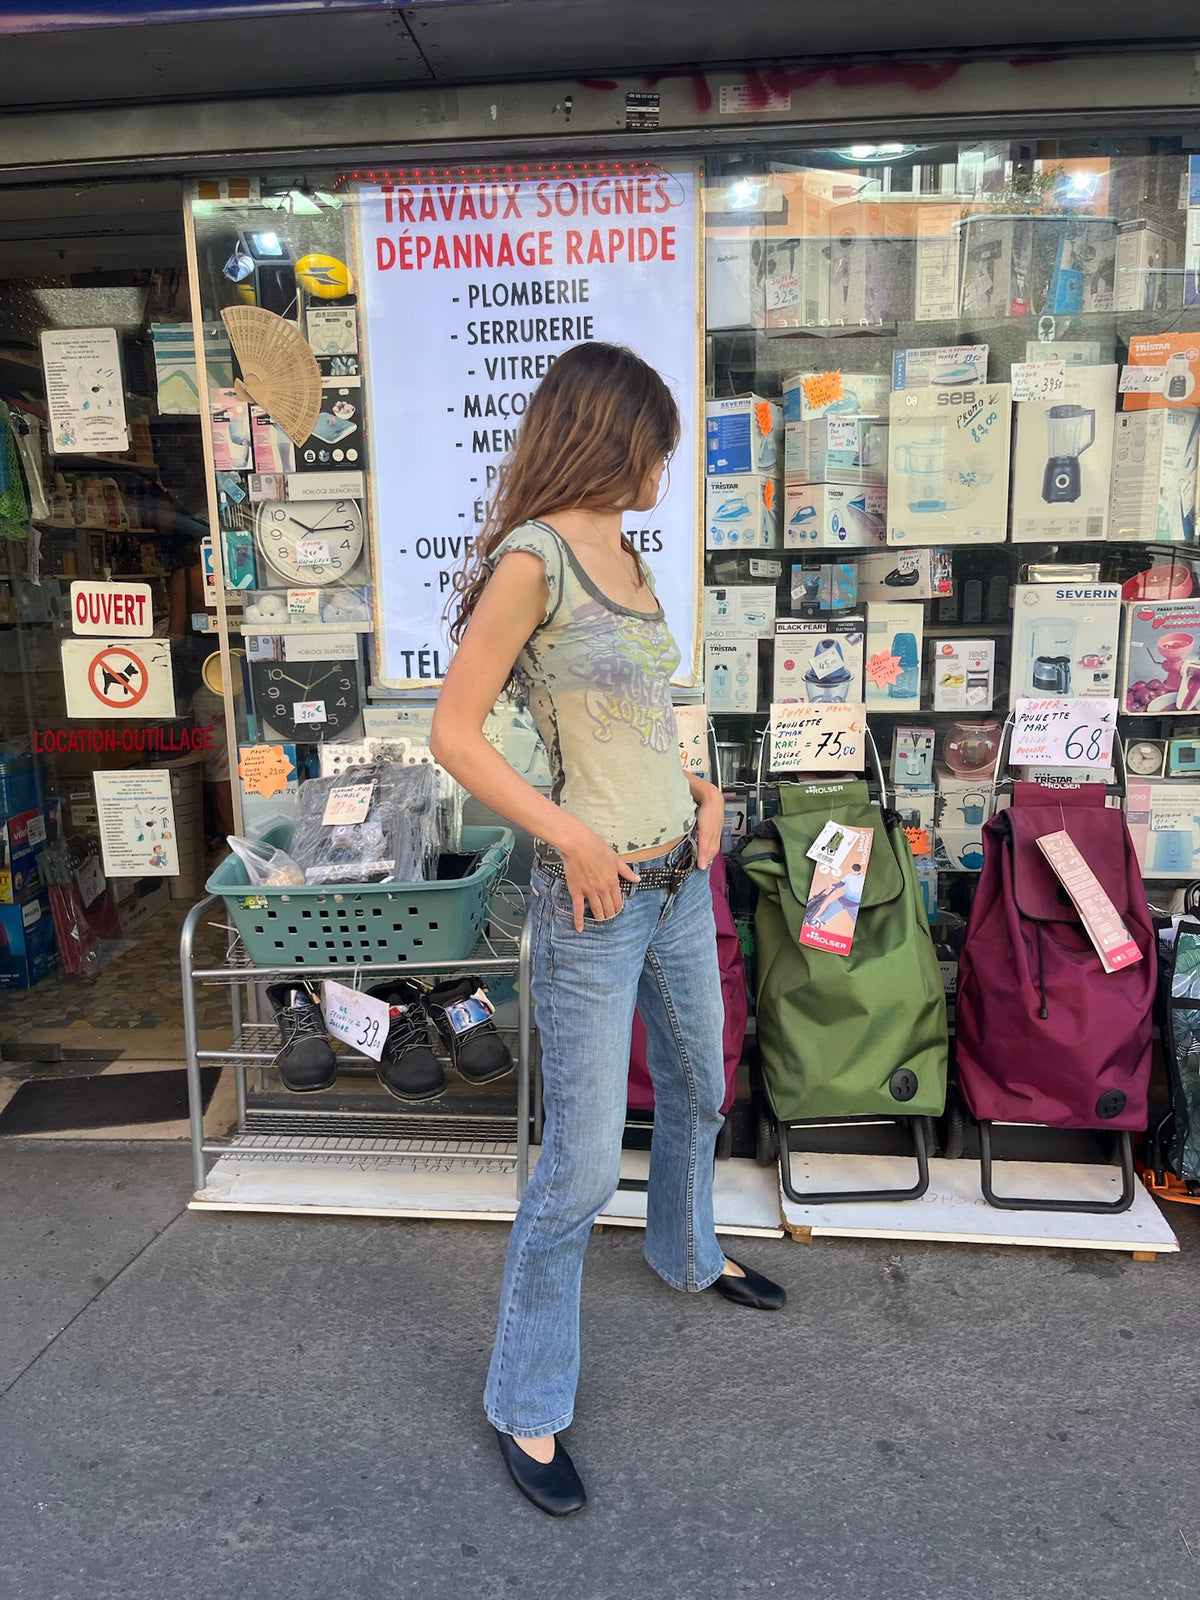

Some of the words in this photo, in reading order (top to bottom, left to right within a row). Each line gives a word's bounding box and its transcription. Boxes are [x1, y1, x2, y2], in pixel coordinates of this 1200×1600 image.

[381, 183, 522, 223] TRAVAUX
[536, 174, 670, 217] SOIGNÉS
[376, 229, 553, 271] DÉPANNAGE
[566, 226, 676, 265] RAPIDE
[468, 279, 589, 308] PLOMBERIE
[467, 316, 594, 346] SERRURERIE
[720, 400, 750, 408] SEVERIN
[906, 396, 918, 406] 08
[957, 399, 984, 429] PROMO
[711, 482, 738, 490] TRISTAR
[1056, 590, 1118, 598] SEVERIN
[76, 592, 146, 626] OUVERT
[778, 708, 812, 718] SUPER
[1026, 700, 1061, 710] SUPER
[1024, 724, 1048, 732] MAX
[34, 727, 215, 753] LOCATION-OUTILLAGE
[775, 738, 798, 749] KAKI
[815, 732, 856, 760] 75,00
[1034, 774, 1072, 784] TRISTAR
[813, 785, 844, 794] ROLSER
[857, 831, 866, 852] SMART
[861, 833, 872, 865] SHOPPING
[813, 936, 847, 950] ROLSER
